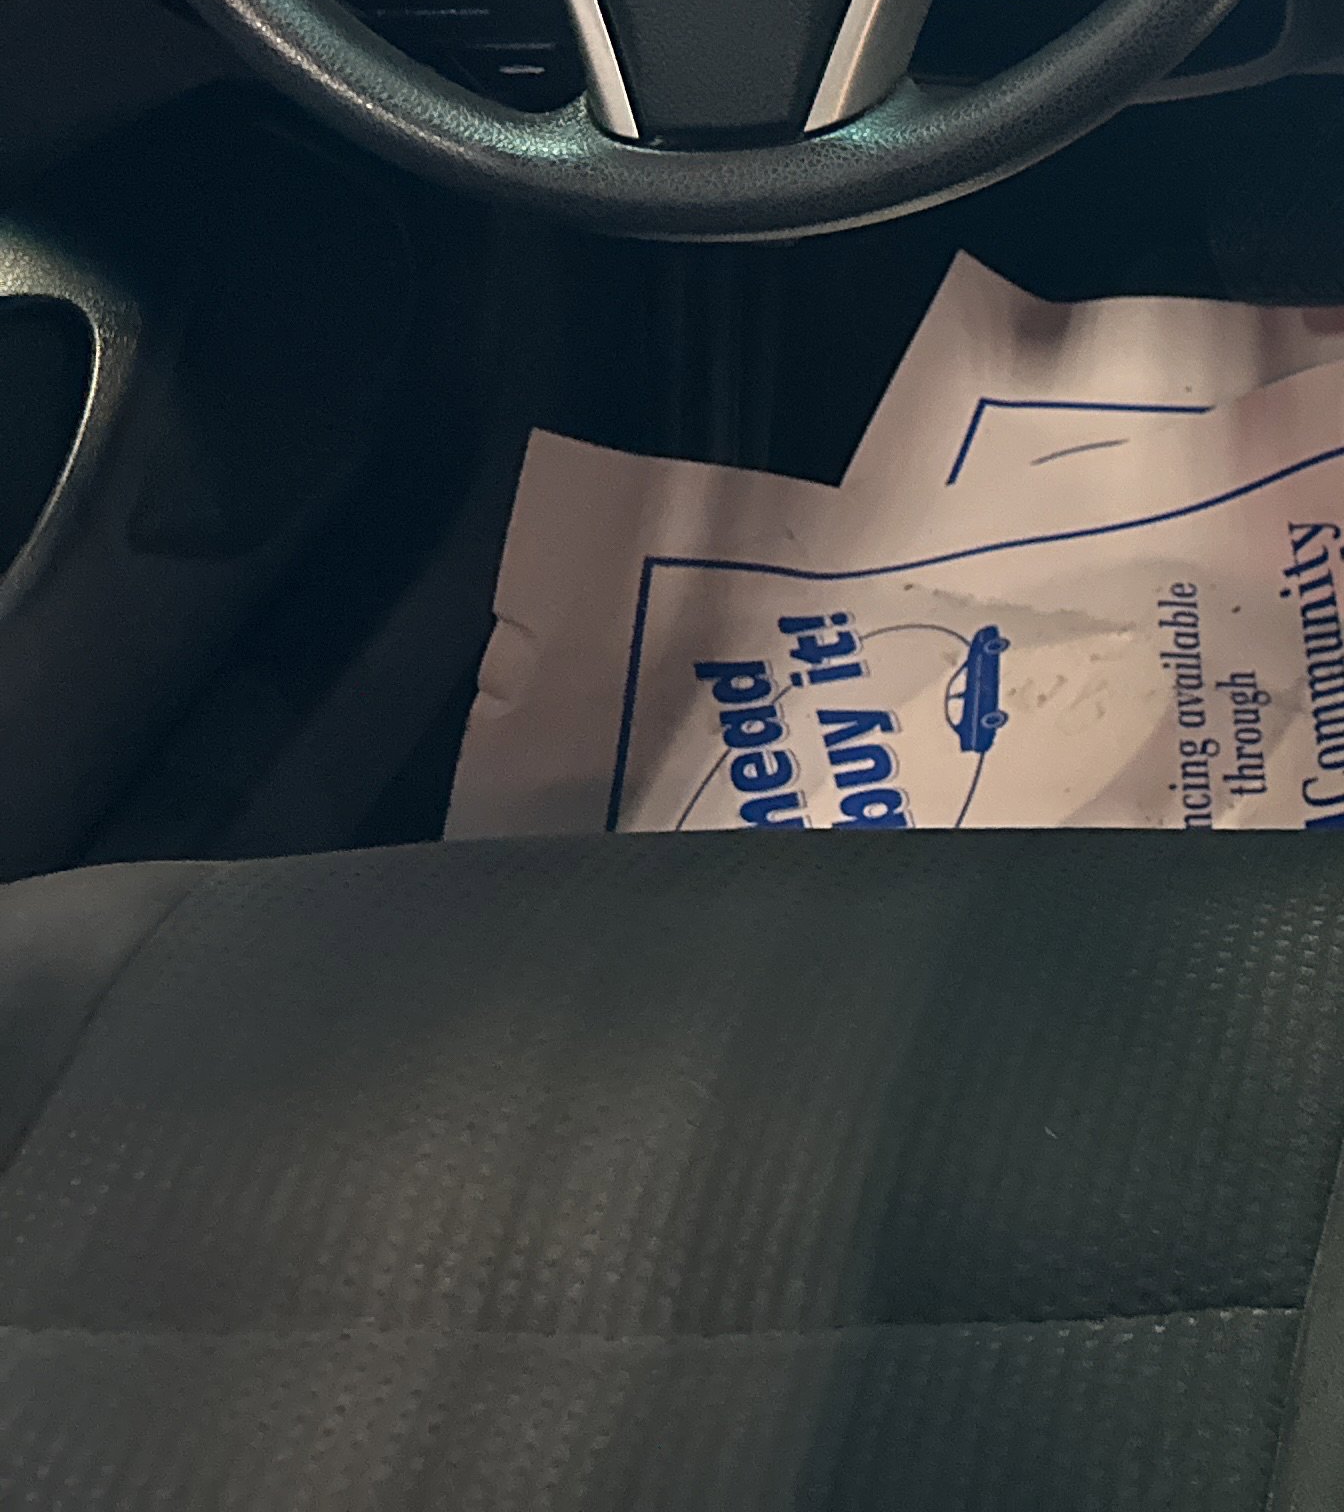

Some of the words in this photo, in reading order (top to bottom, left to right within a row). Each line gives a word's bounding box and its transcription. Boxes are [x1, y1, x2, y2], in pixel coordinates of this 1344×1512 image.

[777, 611, 864, 688] it!
[1158, 581, 1206, 729] available
[694, 659, 808, 828] head
[1168, 738, 1220, 829] ncing
[1216, 670, 1271, 798] through
